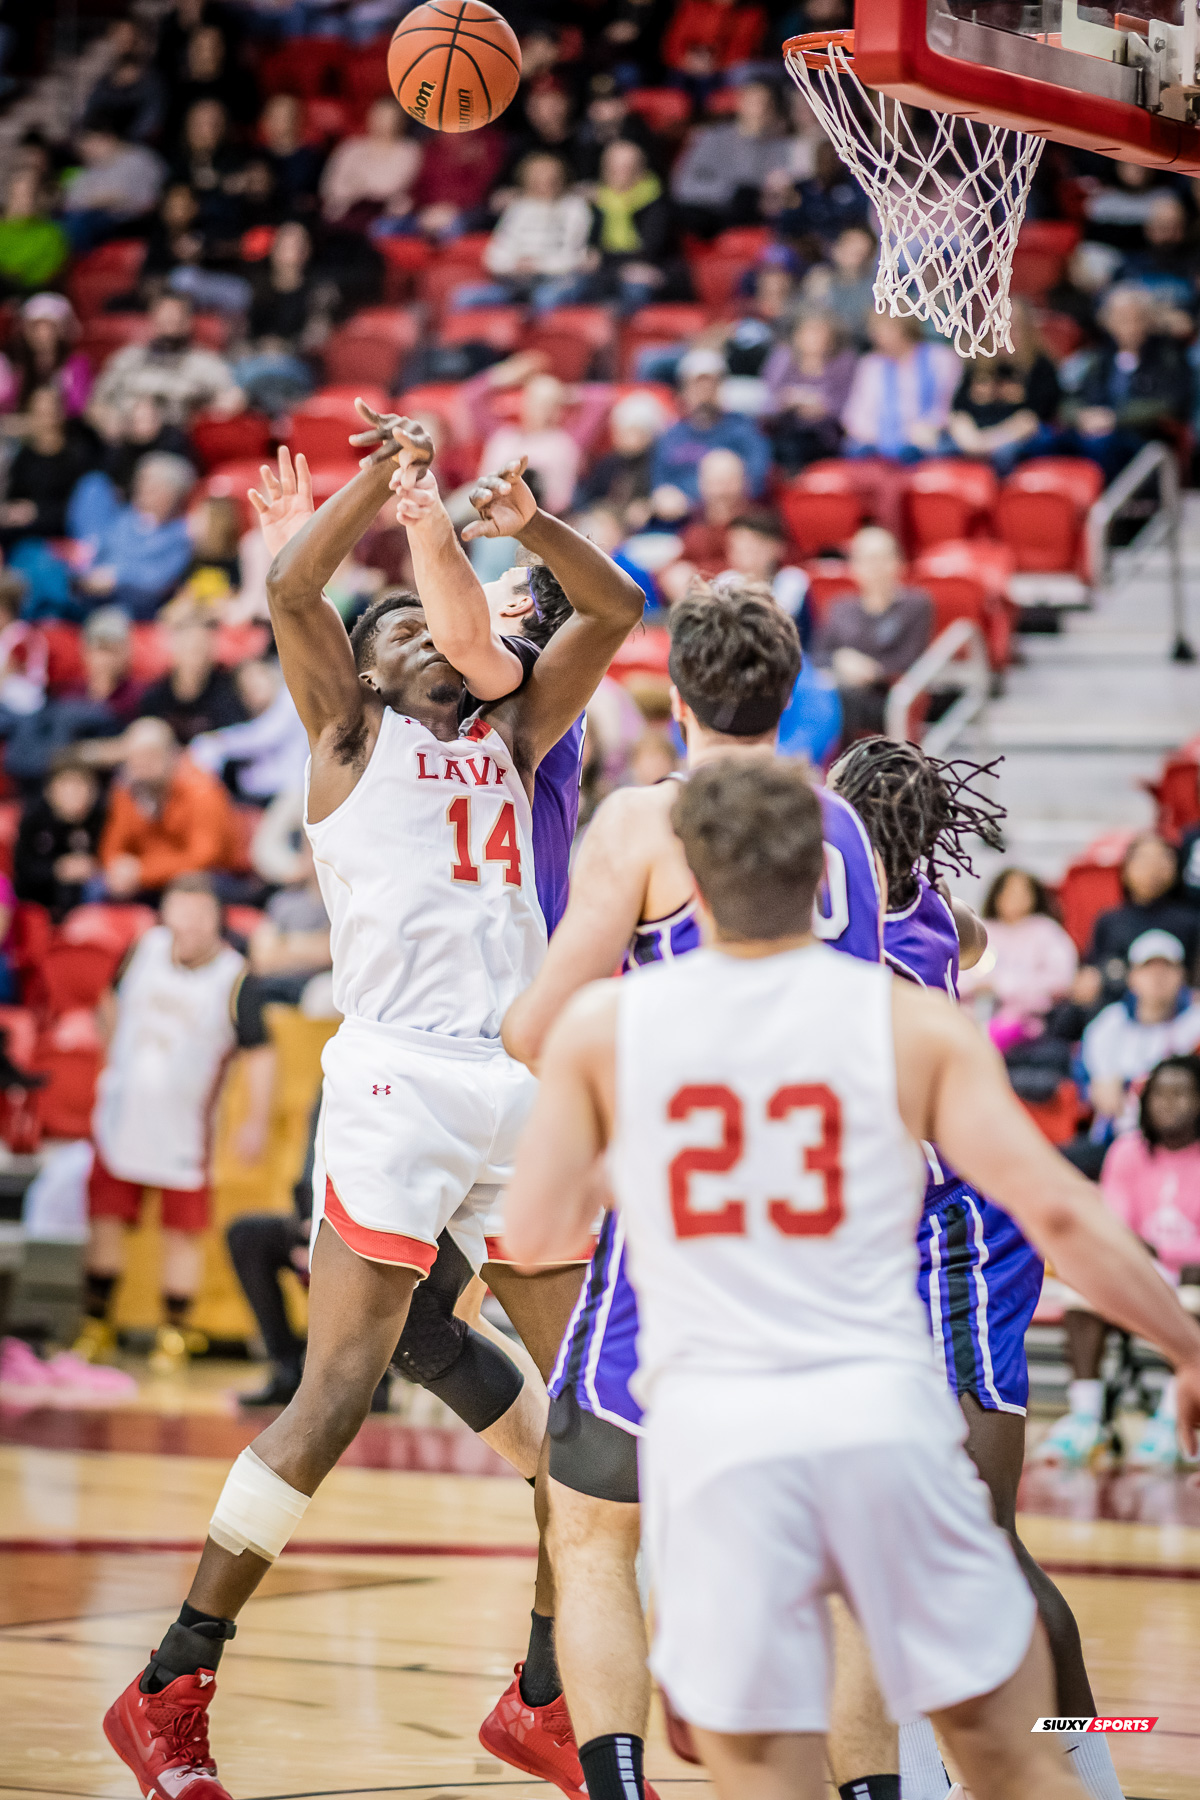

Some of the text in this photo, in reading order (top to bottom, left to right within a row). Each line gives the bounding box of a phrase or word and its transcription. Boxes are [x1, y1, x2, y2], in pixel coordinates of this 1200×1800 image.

[407, 80, 437, 122] lson
[446, 795, 522, 891] 14
[668, 1082, 843, 1240] 23
